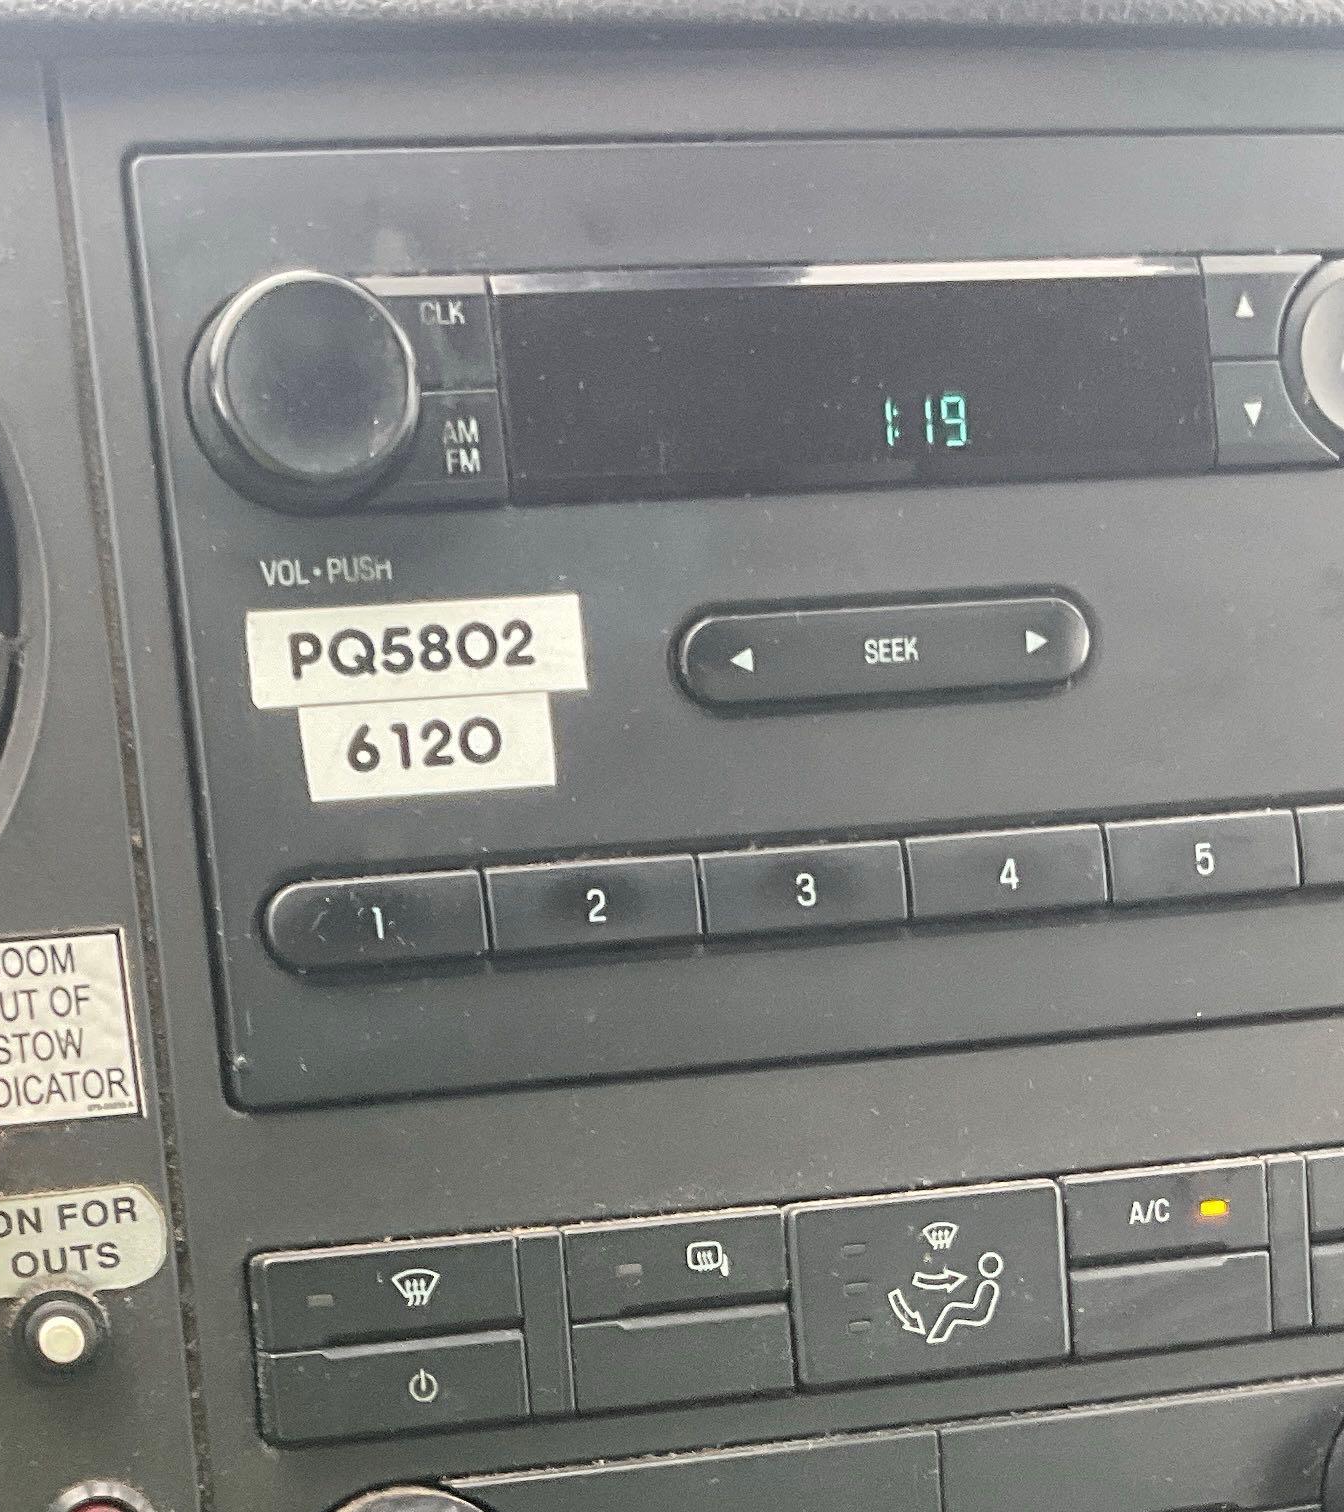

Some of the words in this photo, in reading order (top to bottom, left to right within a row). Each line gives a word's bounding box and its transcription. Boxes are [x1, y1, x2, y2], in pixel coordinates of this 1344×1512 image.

[419, 301, 466, 326] CLK
[443, 417, 480, 446] AM
[882, 392, 968, 448] 1:19
[445, 447, 482, 475] FM
[288, 618, 537, 680] PQ5802
[863, 636, 920, 665] SEEK
[346, 715, 503, 774] 6120
[371, 906, 383, 941] 1
[585, 888, 607, 924] 2
[794, 872, 817, 908] 3
[998, 857, 1021, 892] 4
[1193, 841, 1216, 877] 5
[49, 983, 90, 1019] OF
[58, 1195, 140, 1232] FOR
[1128, 1198, 1171, 1226] A/C
[10, 1241, 122, 1279] OUTS
